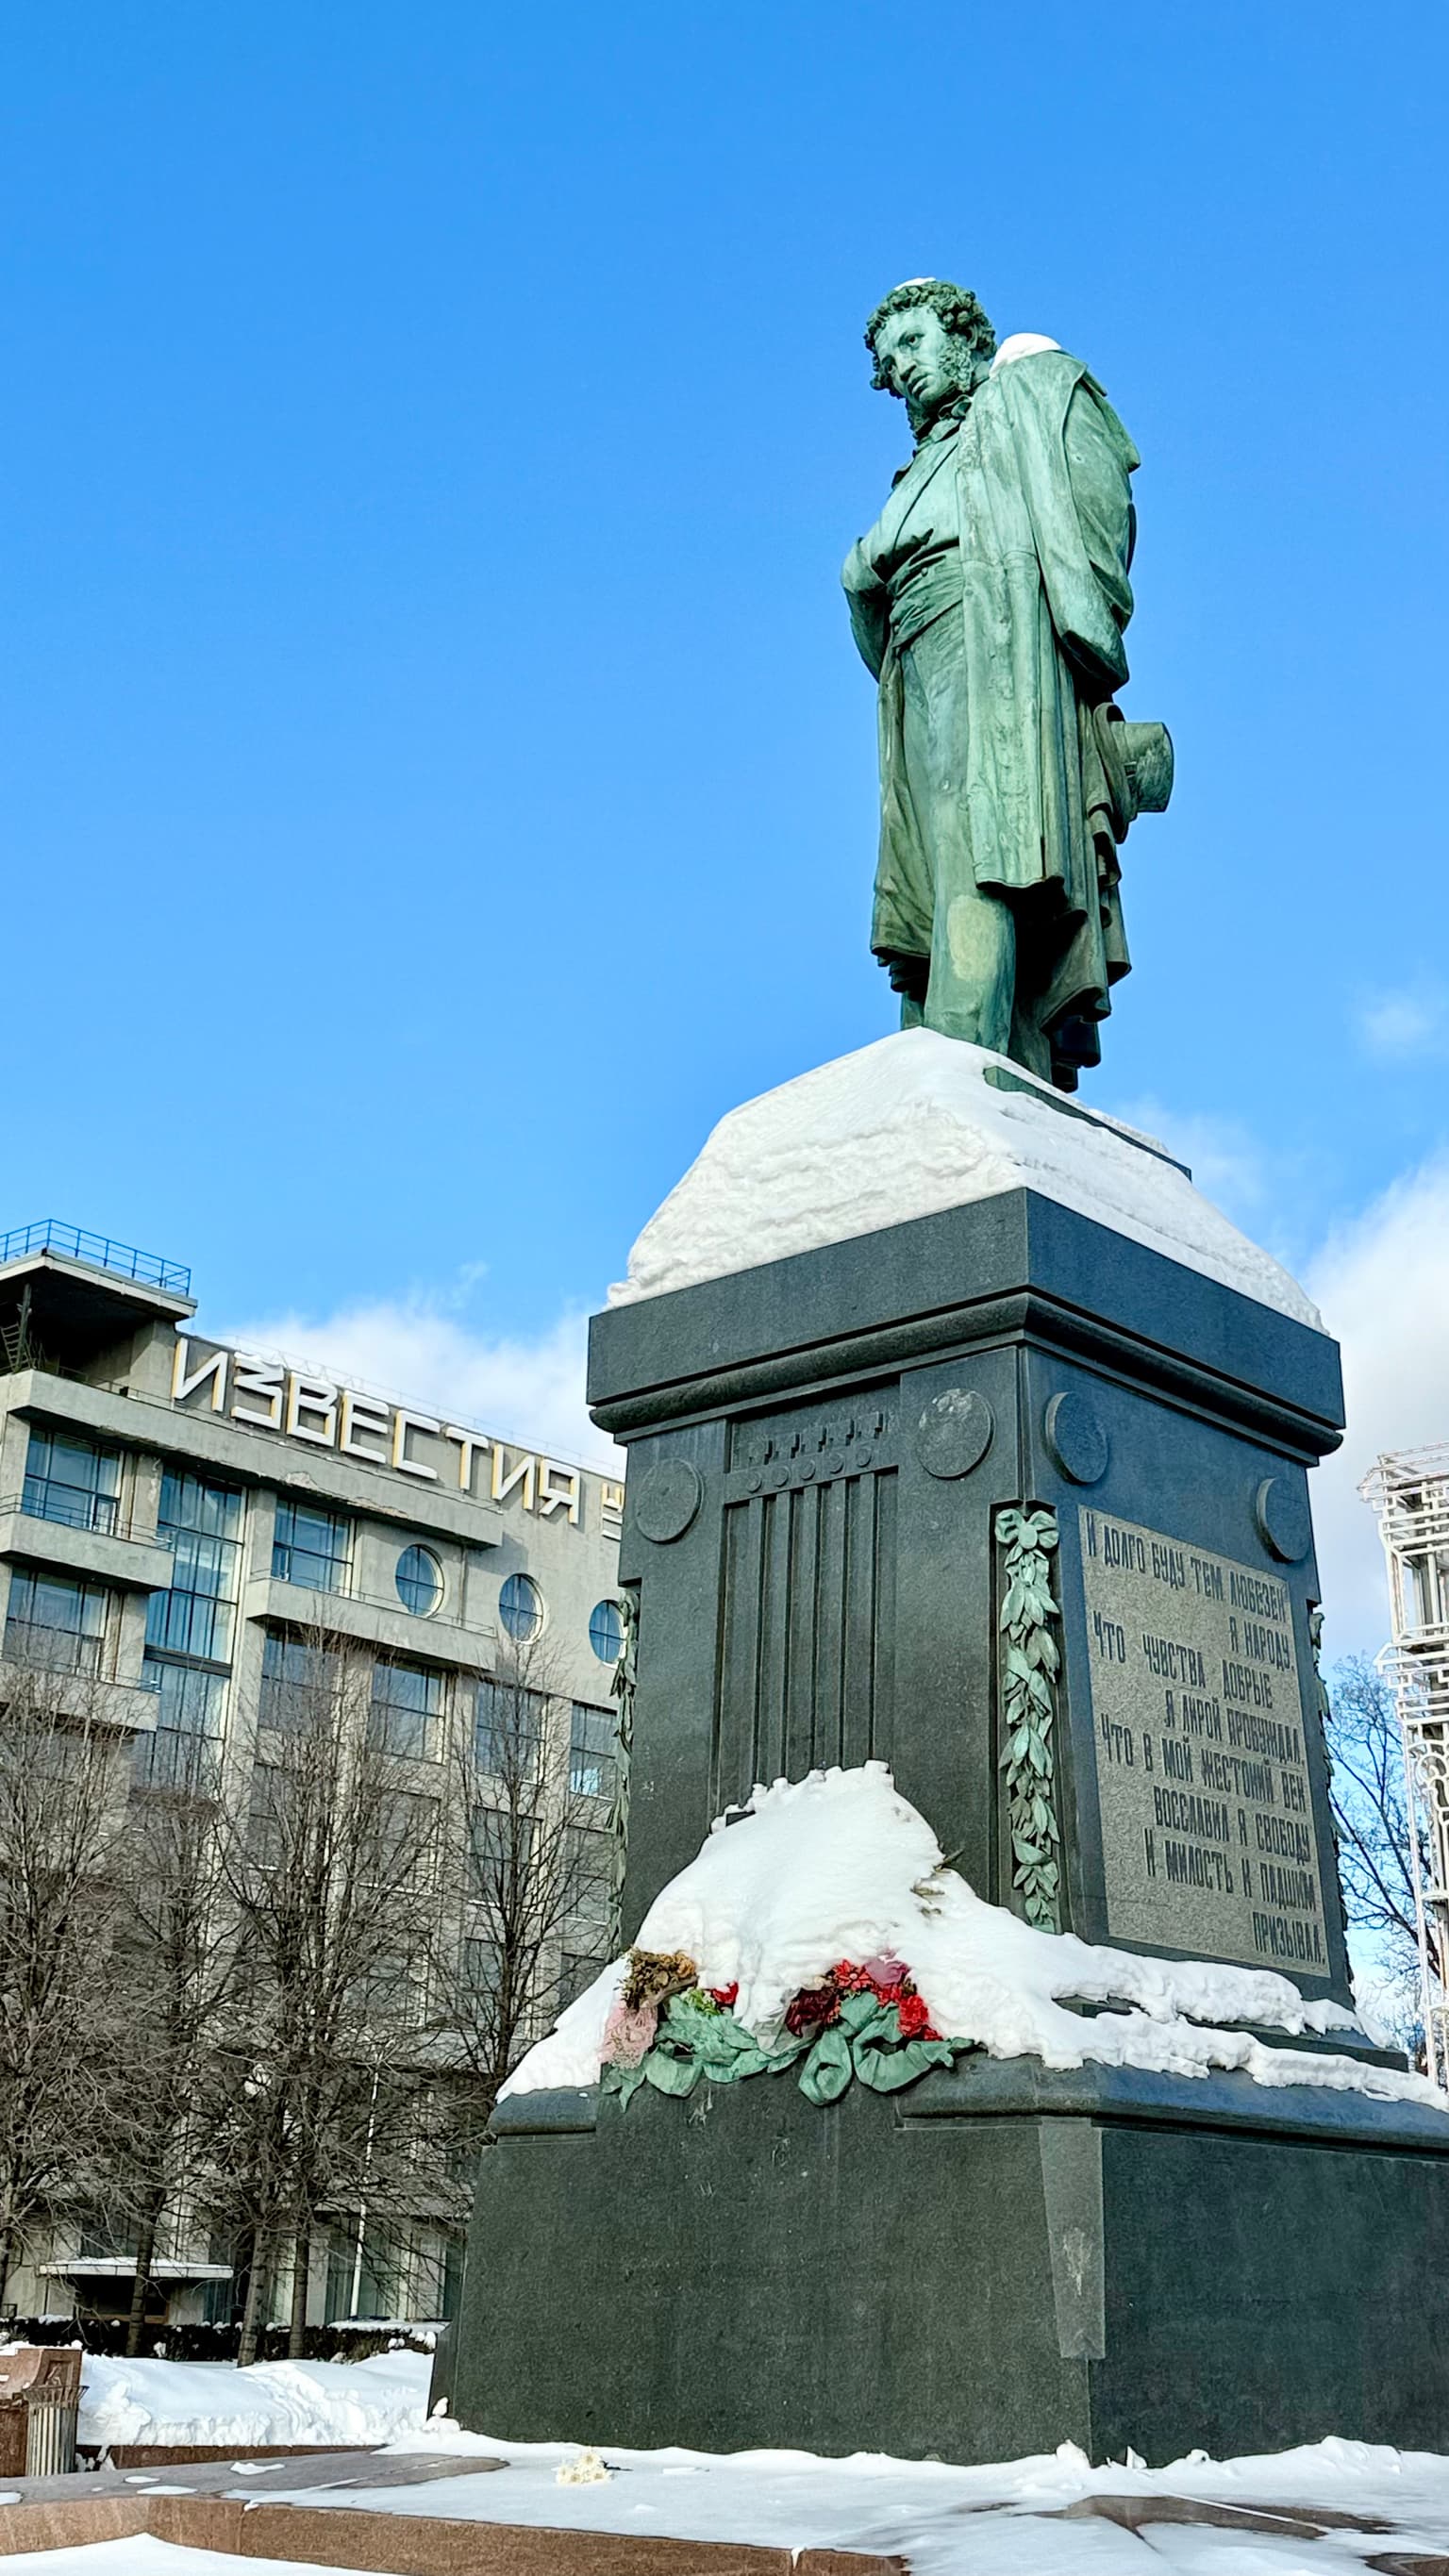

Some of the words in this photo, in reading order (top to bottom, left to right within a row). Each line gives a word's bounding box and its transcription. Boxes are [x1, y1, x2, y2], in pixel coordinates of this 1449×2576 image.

[172, 1338, 581, 1524] ИЗВЕСТИЯ
[1087, 1512, 1096, 1557] И
[1104, 1524, 1145, 1574] ДОЛГО
[1151, 1542, 1185, 1590] БУДУ
[1191, 1556, 1224, 1602] ТЕМ
[1230, 1571, 1286, 1623] ЛЮБЕЗЕН
[1092, 1610, 1125, 1664] ЧТО
[1142, 1634, 1206, 1688] ЧУВСТВА
[1223, 1659, 1273, 1709] ДОБРЫЕ
[1229, 1616, 1239, 1654] Я
[1164, 1689, 1174, 1728] Я
[1182, 1695, 1223, 1742] ЛИРОЙ
[1101, 1712, 1134, 1767] ЧТО
[1142, 1732, 1153, 1771] В
[1161, 1736, 1193, 1783] МОЙ
[1201, 1748, 1274, 1803] ЖЕСТОКИЙ
[1281, 1770, 1307, 1813] ВЕК
[1154, 1786, 1229, 1842] ВОССЛАВИЛ
[1238, 1808, 1248, 1846] Я
[1256, 1813, 1311, 1867] СВОБОДУ
[1144, 1828, 1156, 1877] И
[1165, 1840, 1234, 1893] МИЛОСТЬ
[1241, 1858, 1253, 1898] К
[1260, 1862, 1317, 1912] ПАДШИМ
[1253, 1911, 1325, 1965] ПРИЗЫВАЛ.
